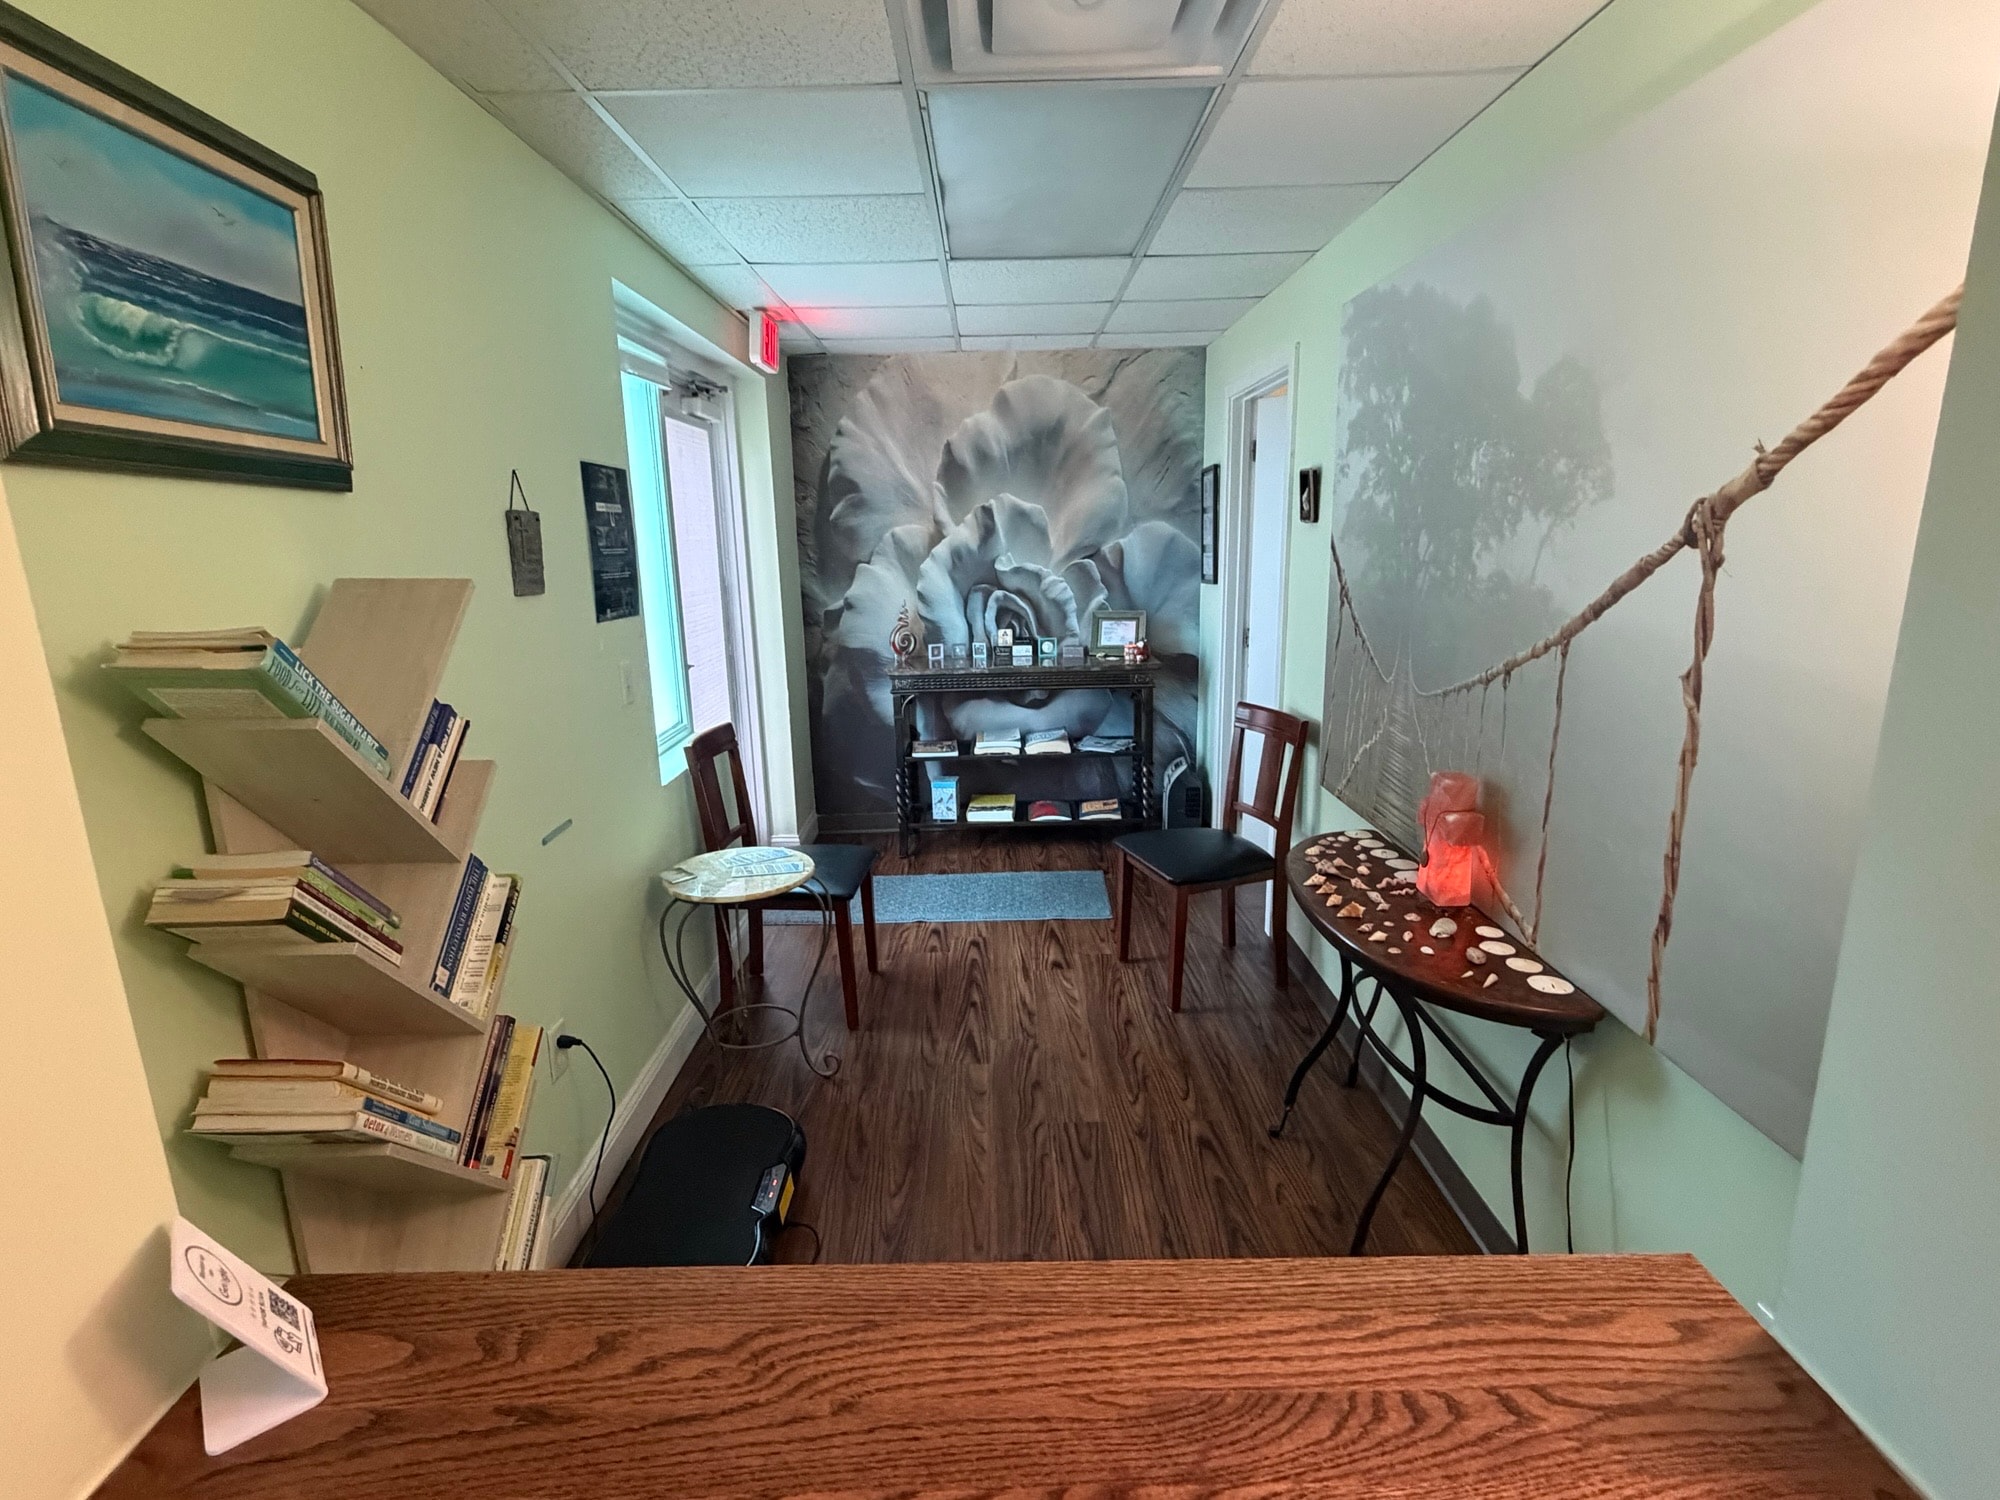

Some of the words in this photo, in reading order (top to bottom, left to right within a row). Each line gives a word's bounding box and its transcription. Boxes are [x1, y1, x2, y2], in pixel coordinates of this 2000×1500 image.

[267, 656, 292, 687] FOOD
[301, 688, 325, 718] LIFE
[294, 660, 314, 687] LICK
[314, 683, 333, 704] THE
[331, 699, 356, 729] SUGAR
[354, 726, 380, 750] HABIT
[464, 885, 475, 911] FOOD
[445, 912, 467, 969] REVOLUTION
[363, 1117, 385, 1133] detox
